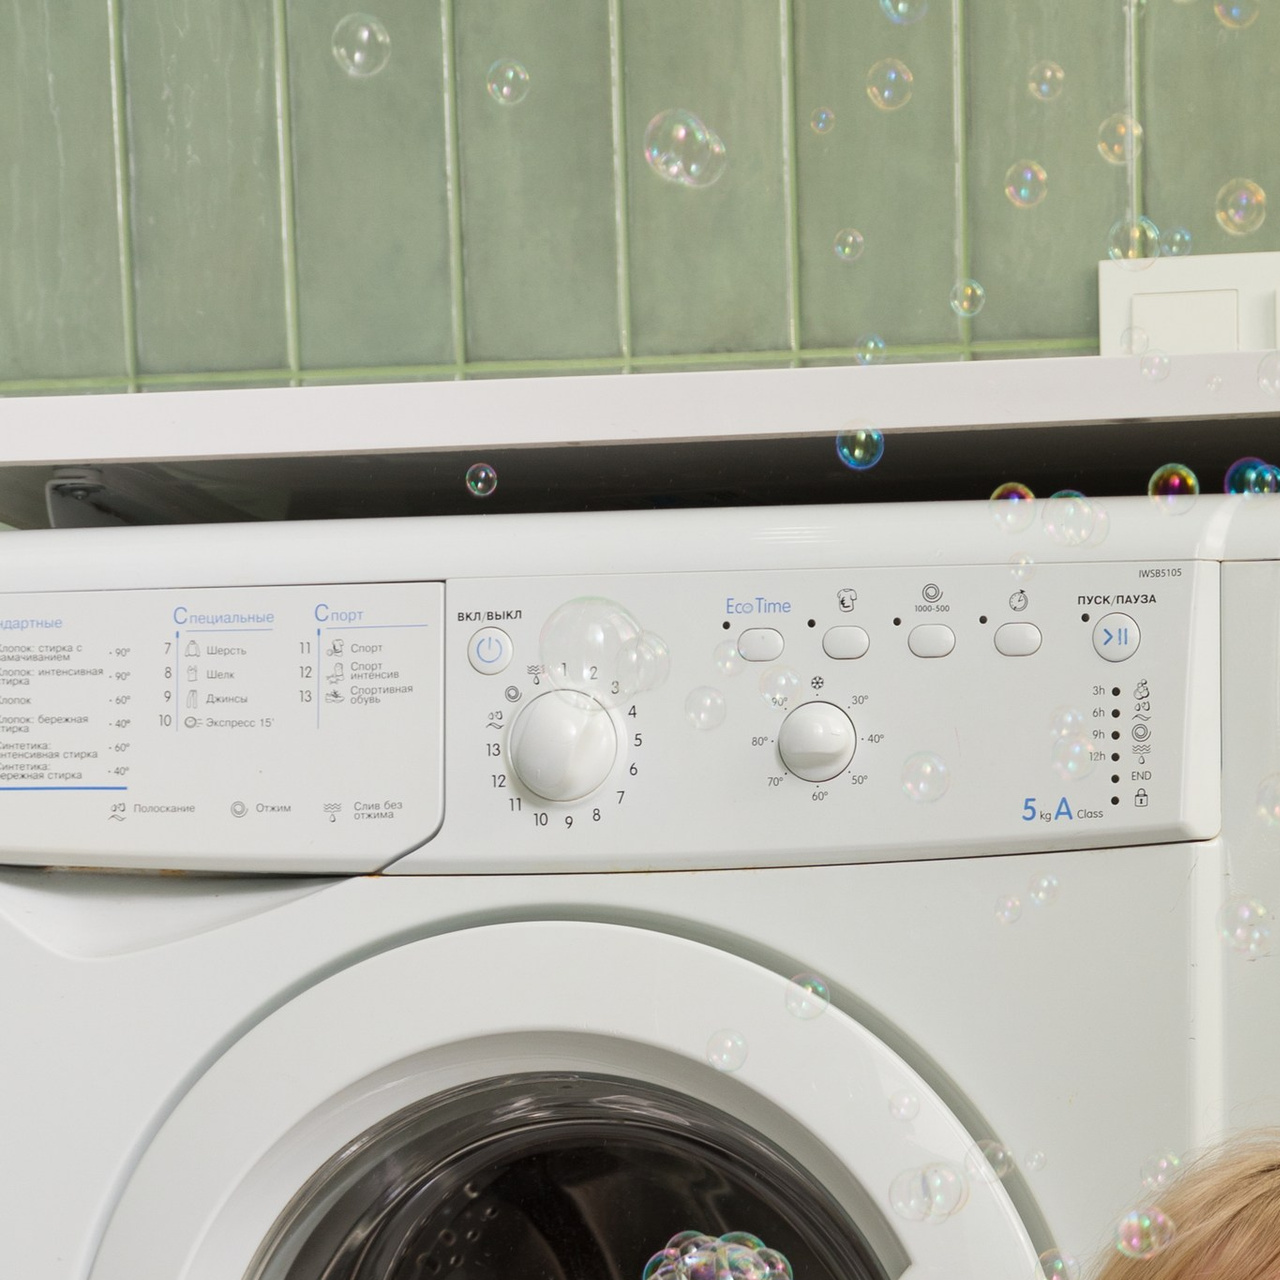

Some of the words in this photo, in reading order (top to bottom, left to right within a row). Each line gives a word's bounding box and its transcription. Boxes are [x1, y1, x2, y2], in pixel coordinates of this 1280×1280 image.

[1138, 568, 1182, 578] IWSB5105
[1077, 594, 1157, 607] ПУСК/ПАУЗА
[314, 603, 364, 622] Спорт
[914, 604, 950, 613] 1000-500
[173, 606, 275, 625] Специальные
[457, 609, 522, 622] ВКЛ/ВЫКЛ
[38, 644, 73, 653] стирка
[76, 644, 83, 652] с
[164, 642, 172, 654] 7
[206, 645, 247, 656] Шерсть
[299, 641, 311, 654] 11
[350, 643, 383, 654] Спорт
[0, 653, 70, 662] амачиванием
[299, 665, 313, 678] 12
[350, 661, 383, 672] Спорт
[560, 663, 568, 676] 1
[38, 668, 104, 677] интенсивная
[164, 666, 172, 679] 8
[206, 669, 235, 680] Шелк
[350, 671, 400, 680] интенсив
[590, 666, 598, 680] 2
[0, 677, 30, 687] тирка
[350, 685, 414, 696] Спортивная
[611, 681, 620, 695] 3
[1092, 685, 1106, 696] 3h
[164, 690, 172, 702] 9
[206, 693, 248, 704] Джинсы
[299, 689, 313, 703] 13
[350, 695, 381, 706] обувь
[628, 705, 638, 719] 4
[1092, 707, 1106, 718] 6h
[38, 714, 89, 725] бережная
[159, 714, 172, 727] 10
[206, 717, 256, 729] Экспресс
[0, 725, 29, 734] тирка
[1092, 729, 1106, 740] 9h
[634, 734, 643, 748] 5
[486, 743, 501, 757] 13
[63, 751, 98, 761] стирка
[1089, 751, 1106, 762] 12h
[629, 762, 638, 776] 6
[0, 771, 45, 781] ережная
[47, 771, 83, 781] стирка
[491, 774, 507, 788] 12
[1131, 771, 1152, 781] END
[617, 791, 626, 804] 7
[133, 803, 196, 814] Полоскание
[256, 803, 291, 813] Отжим
[353, 801, 381, 812] Слив
[384, 801, 403, 811] без
[509, 798, 522, 811] 11
[1022, 797, 1037, 821] 5
[1040, 809, 1052, 823] kg
[1054, 797, 1073, 821] A
[1077, 808, 1104, 820] Class
[353, 810, 394, 820] отжима
[533, 812, 549, 827] 10
[592, 808, 601, 822] 8
[565, 816, 573, 829] 9
